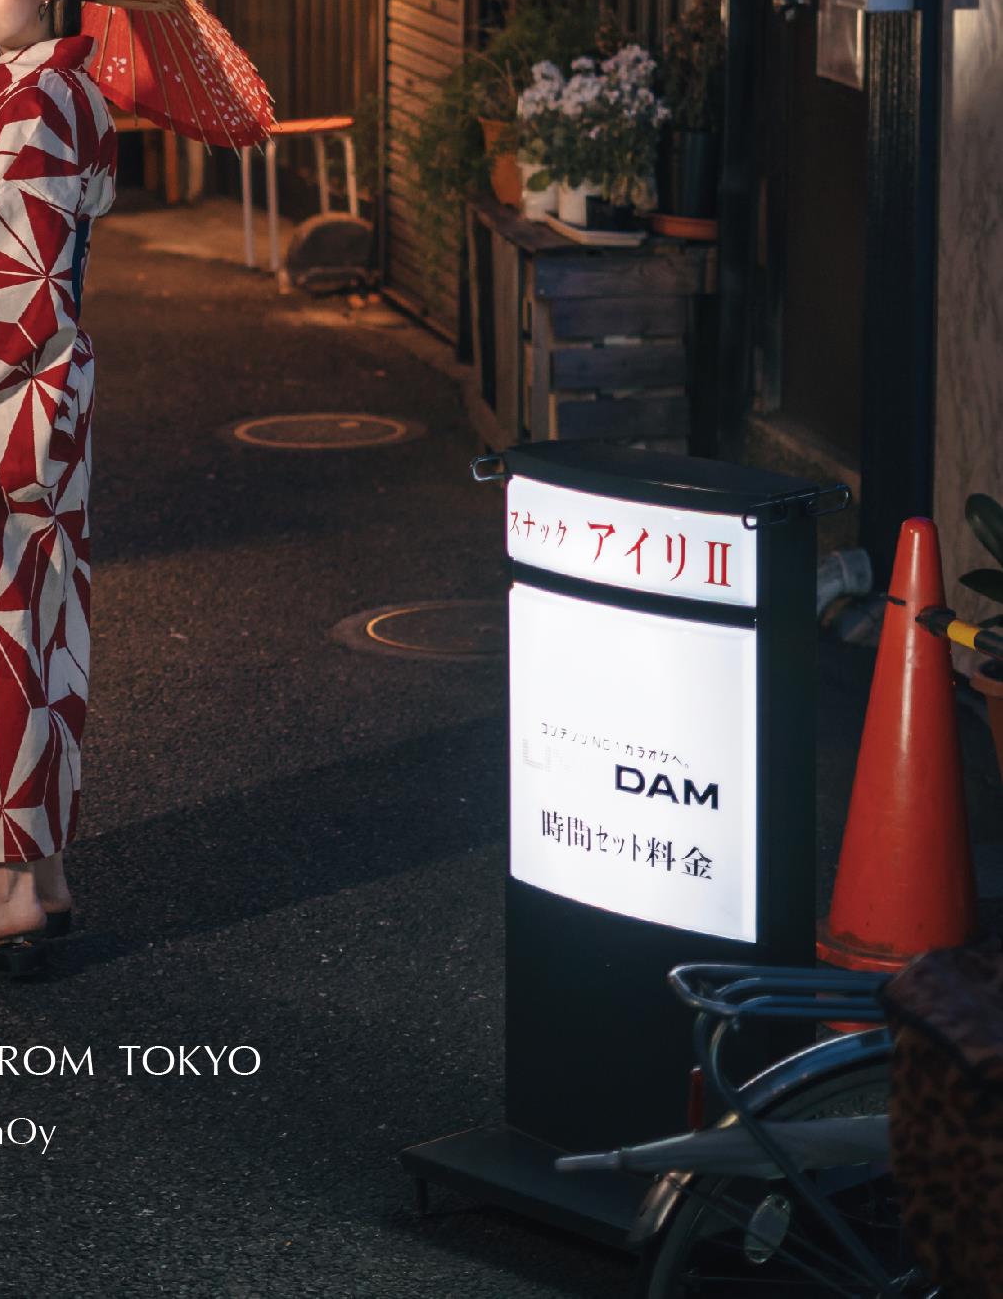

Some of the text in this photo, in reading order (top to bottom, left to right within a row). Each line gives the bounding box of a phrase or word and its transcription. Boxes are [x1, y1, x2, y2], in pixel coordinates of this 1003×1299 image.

[509, 511, 568, 548] スナック
[615, 763, 719, 810] DAM
[541, 809, 713, 880] 時間セット料金
